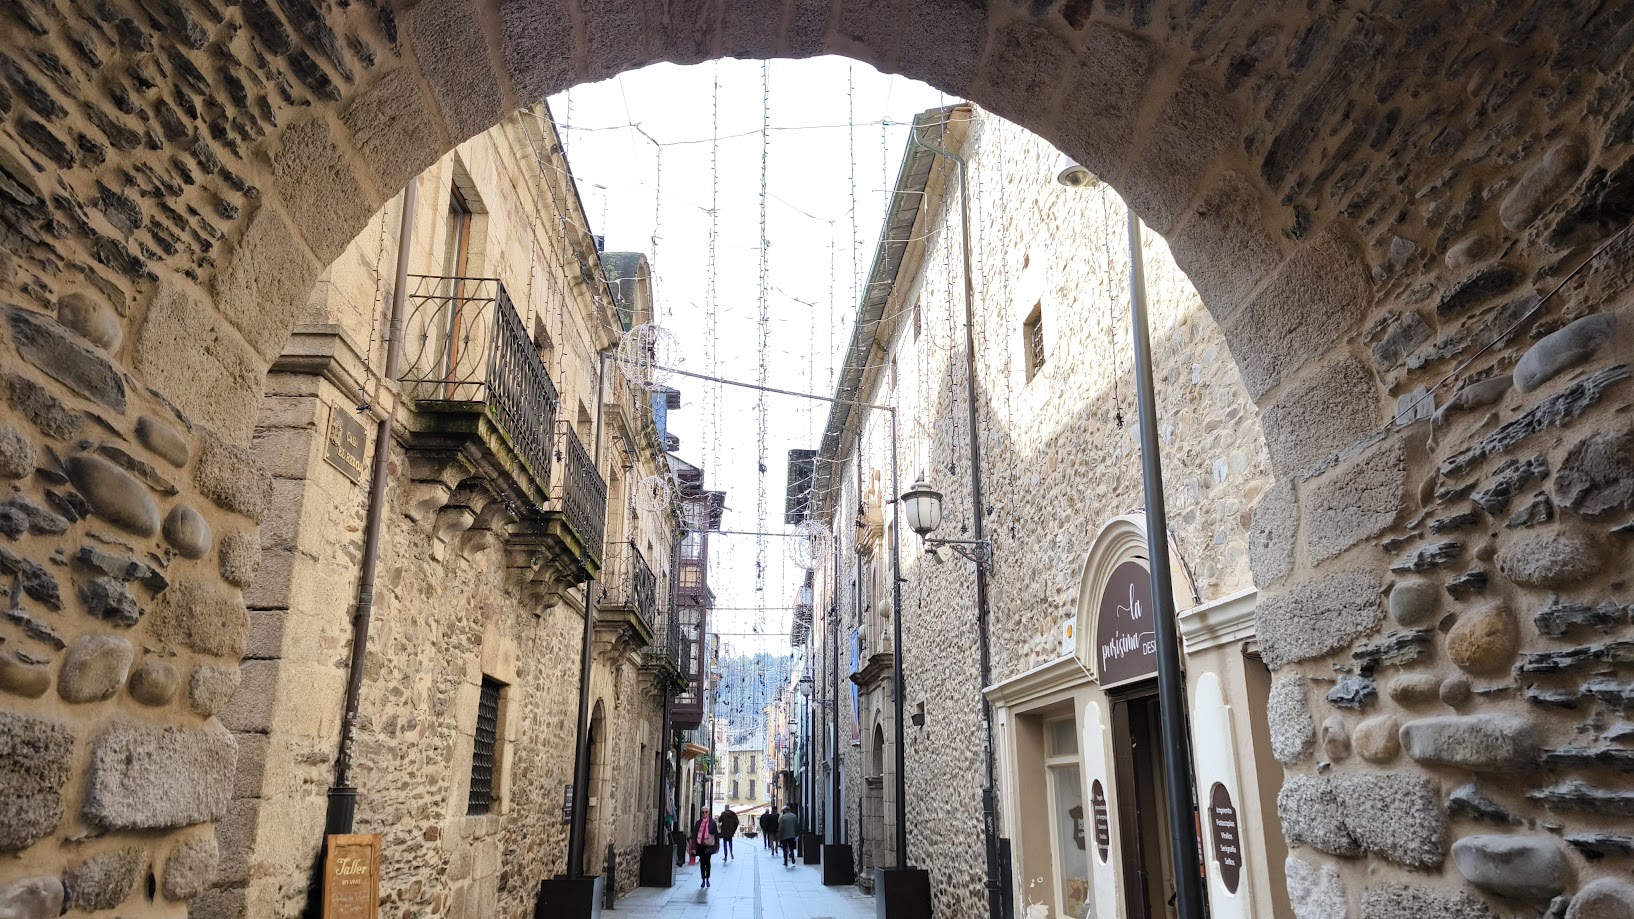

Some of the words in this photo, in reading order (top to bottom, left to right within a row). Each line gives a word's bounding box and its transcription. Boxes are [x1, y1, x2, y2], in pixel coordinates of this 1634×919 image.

[338, 447, 345, 460] EL
[1117, 583, 1142, 620] la
[1142, 639, 1156, 655] DESI
[1216, 807, 1232, 815] Imprenta
[1216, 819, 1235, 828] Fotocopias
[336, 858, 367, 875] Taller
